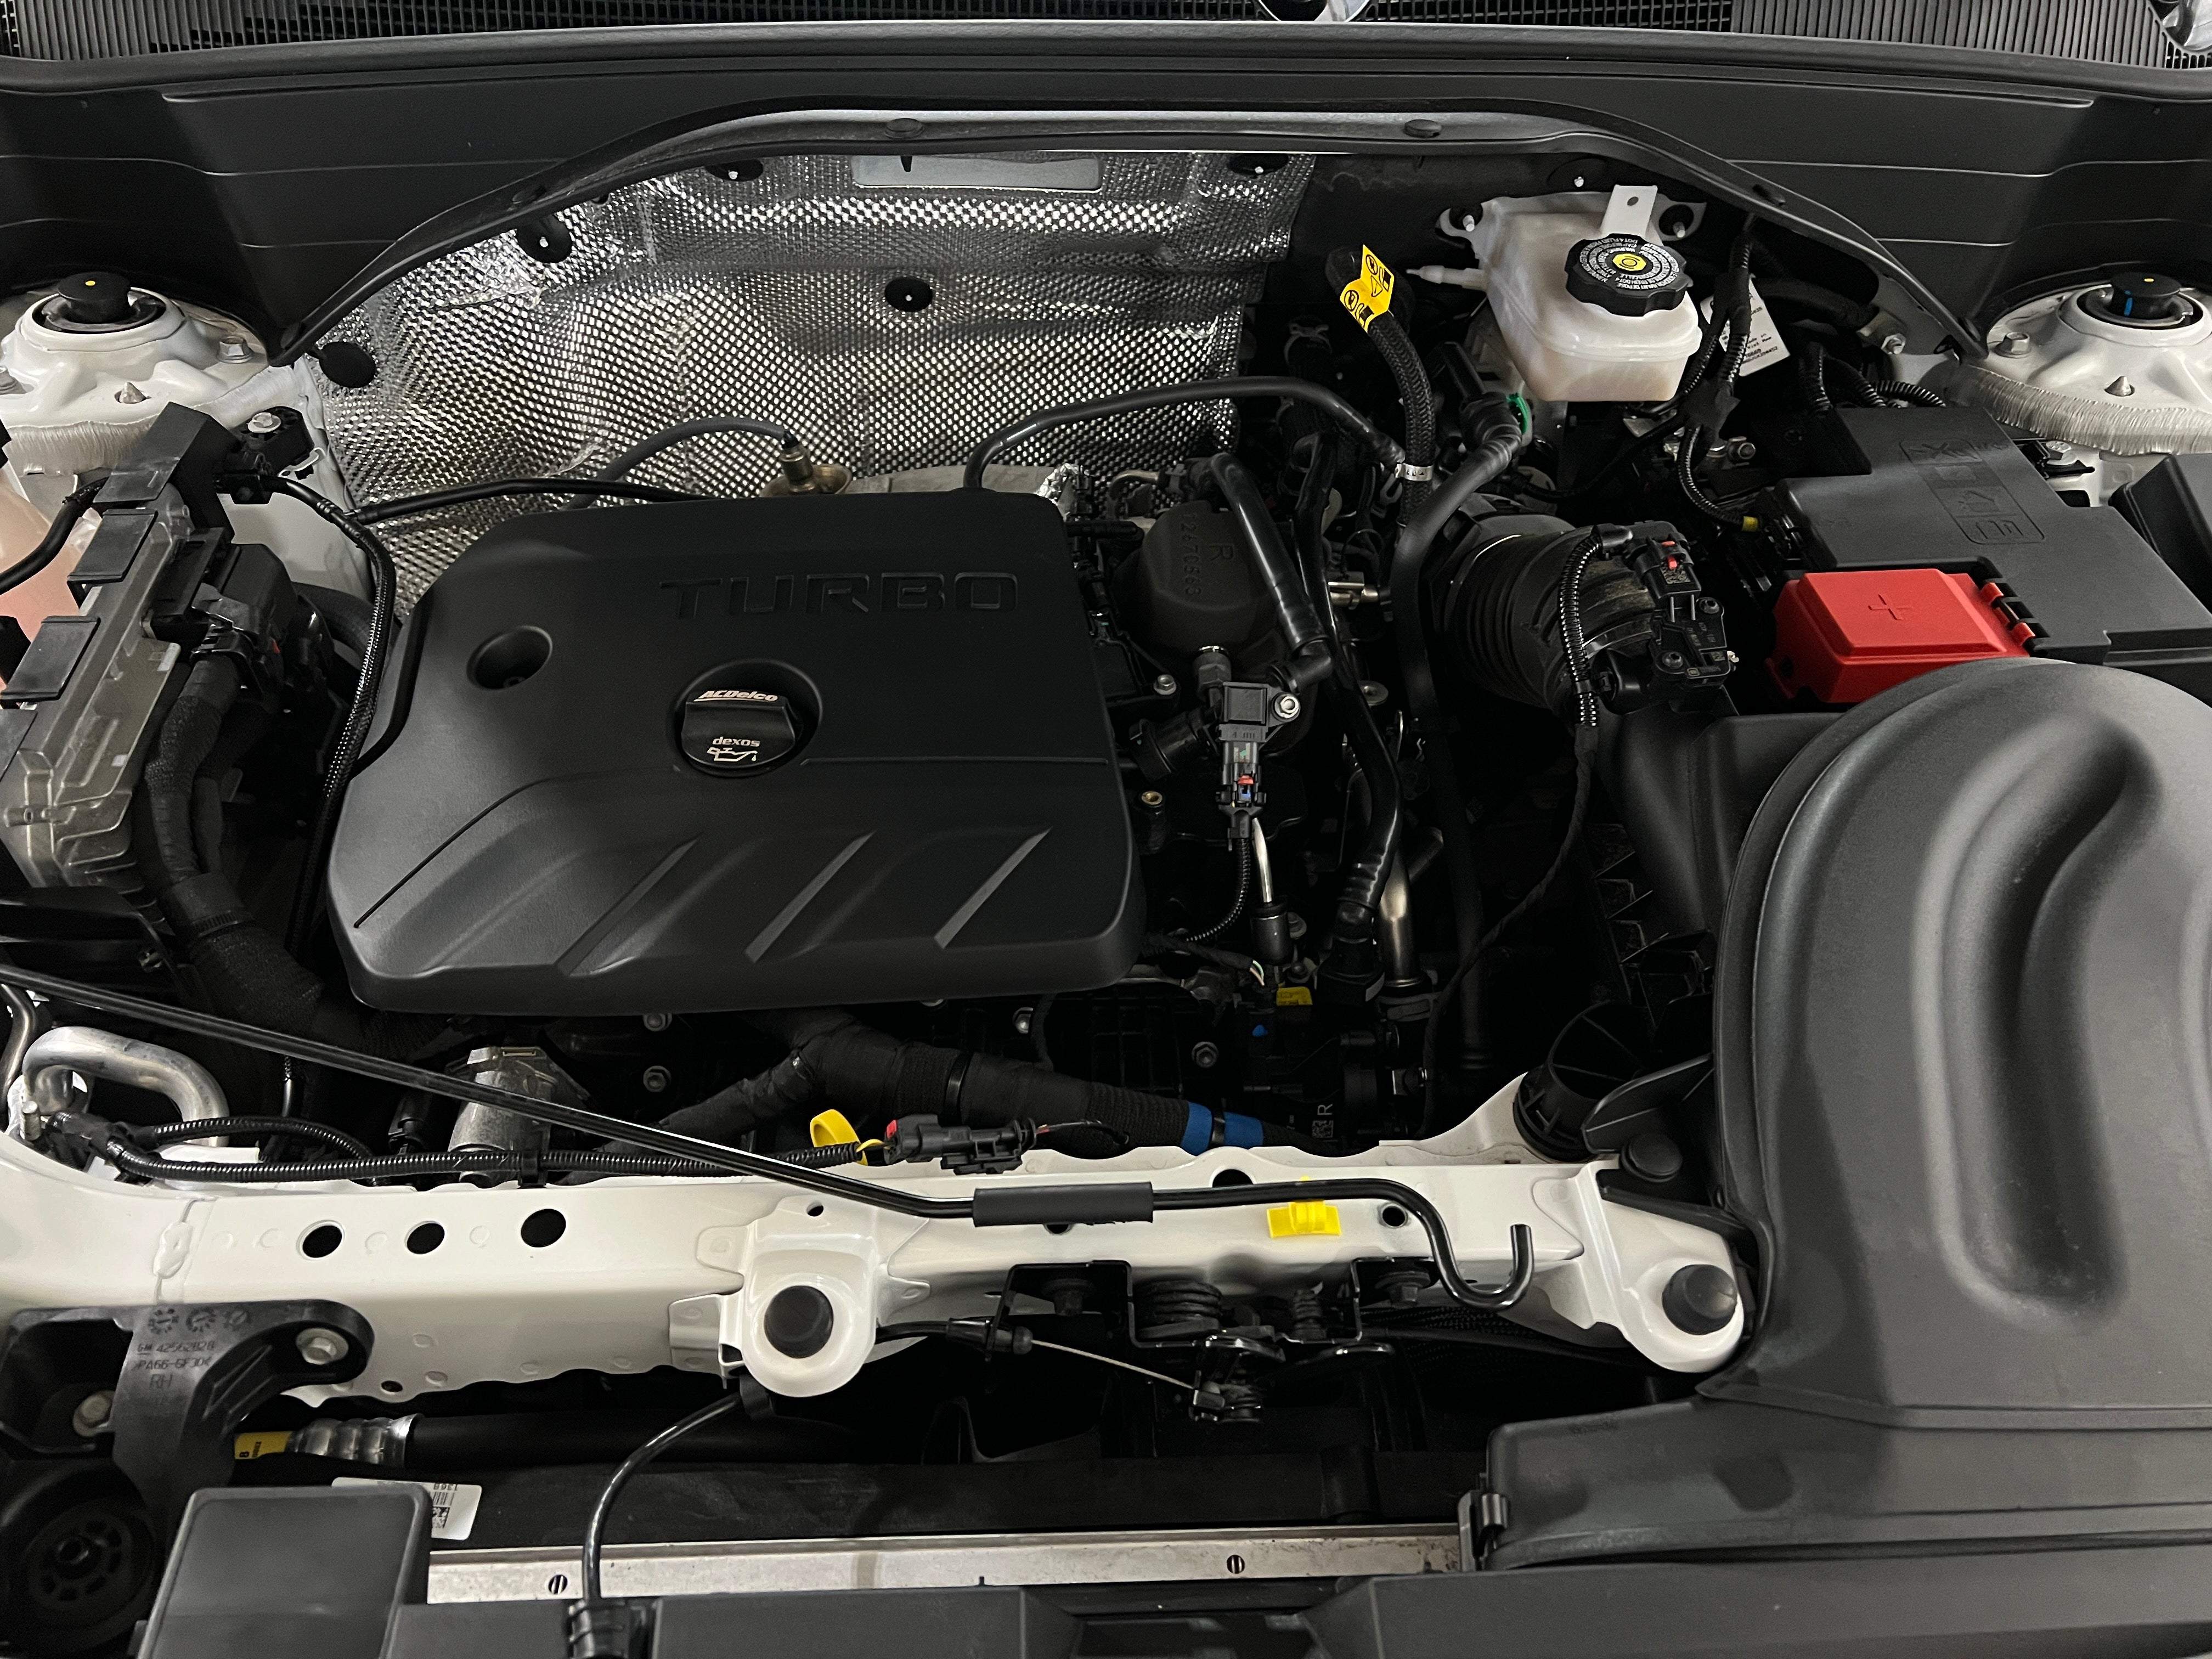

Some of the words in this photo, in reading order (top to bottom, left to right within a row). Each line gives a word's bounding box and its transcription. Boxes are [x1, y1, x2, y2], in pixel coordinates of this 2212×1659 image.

[1207, 544, 1234, 561] R
[659, 572, 1018, 619] TURBO
[694, 690, 778, 701] ACDelco
[712, 736, 761, 748] dexos
